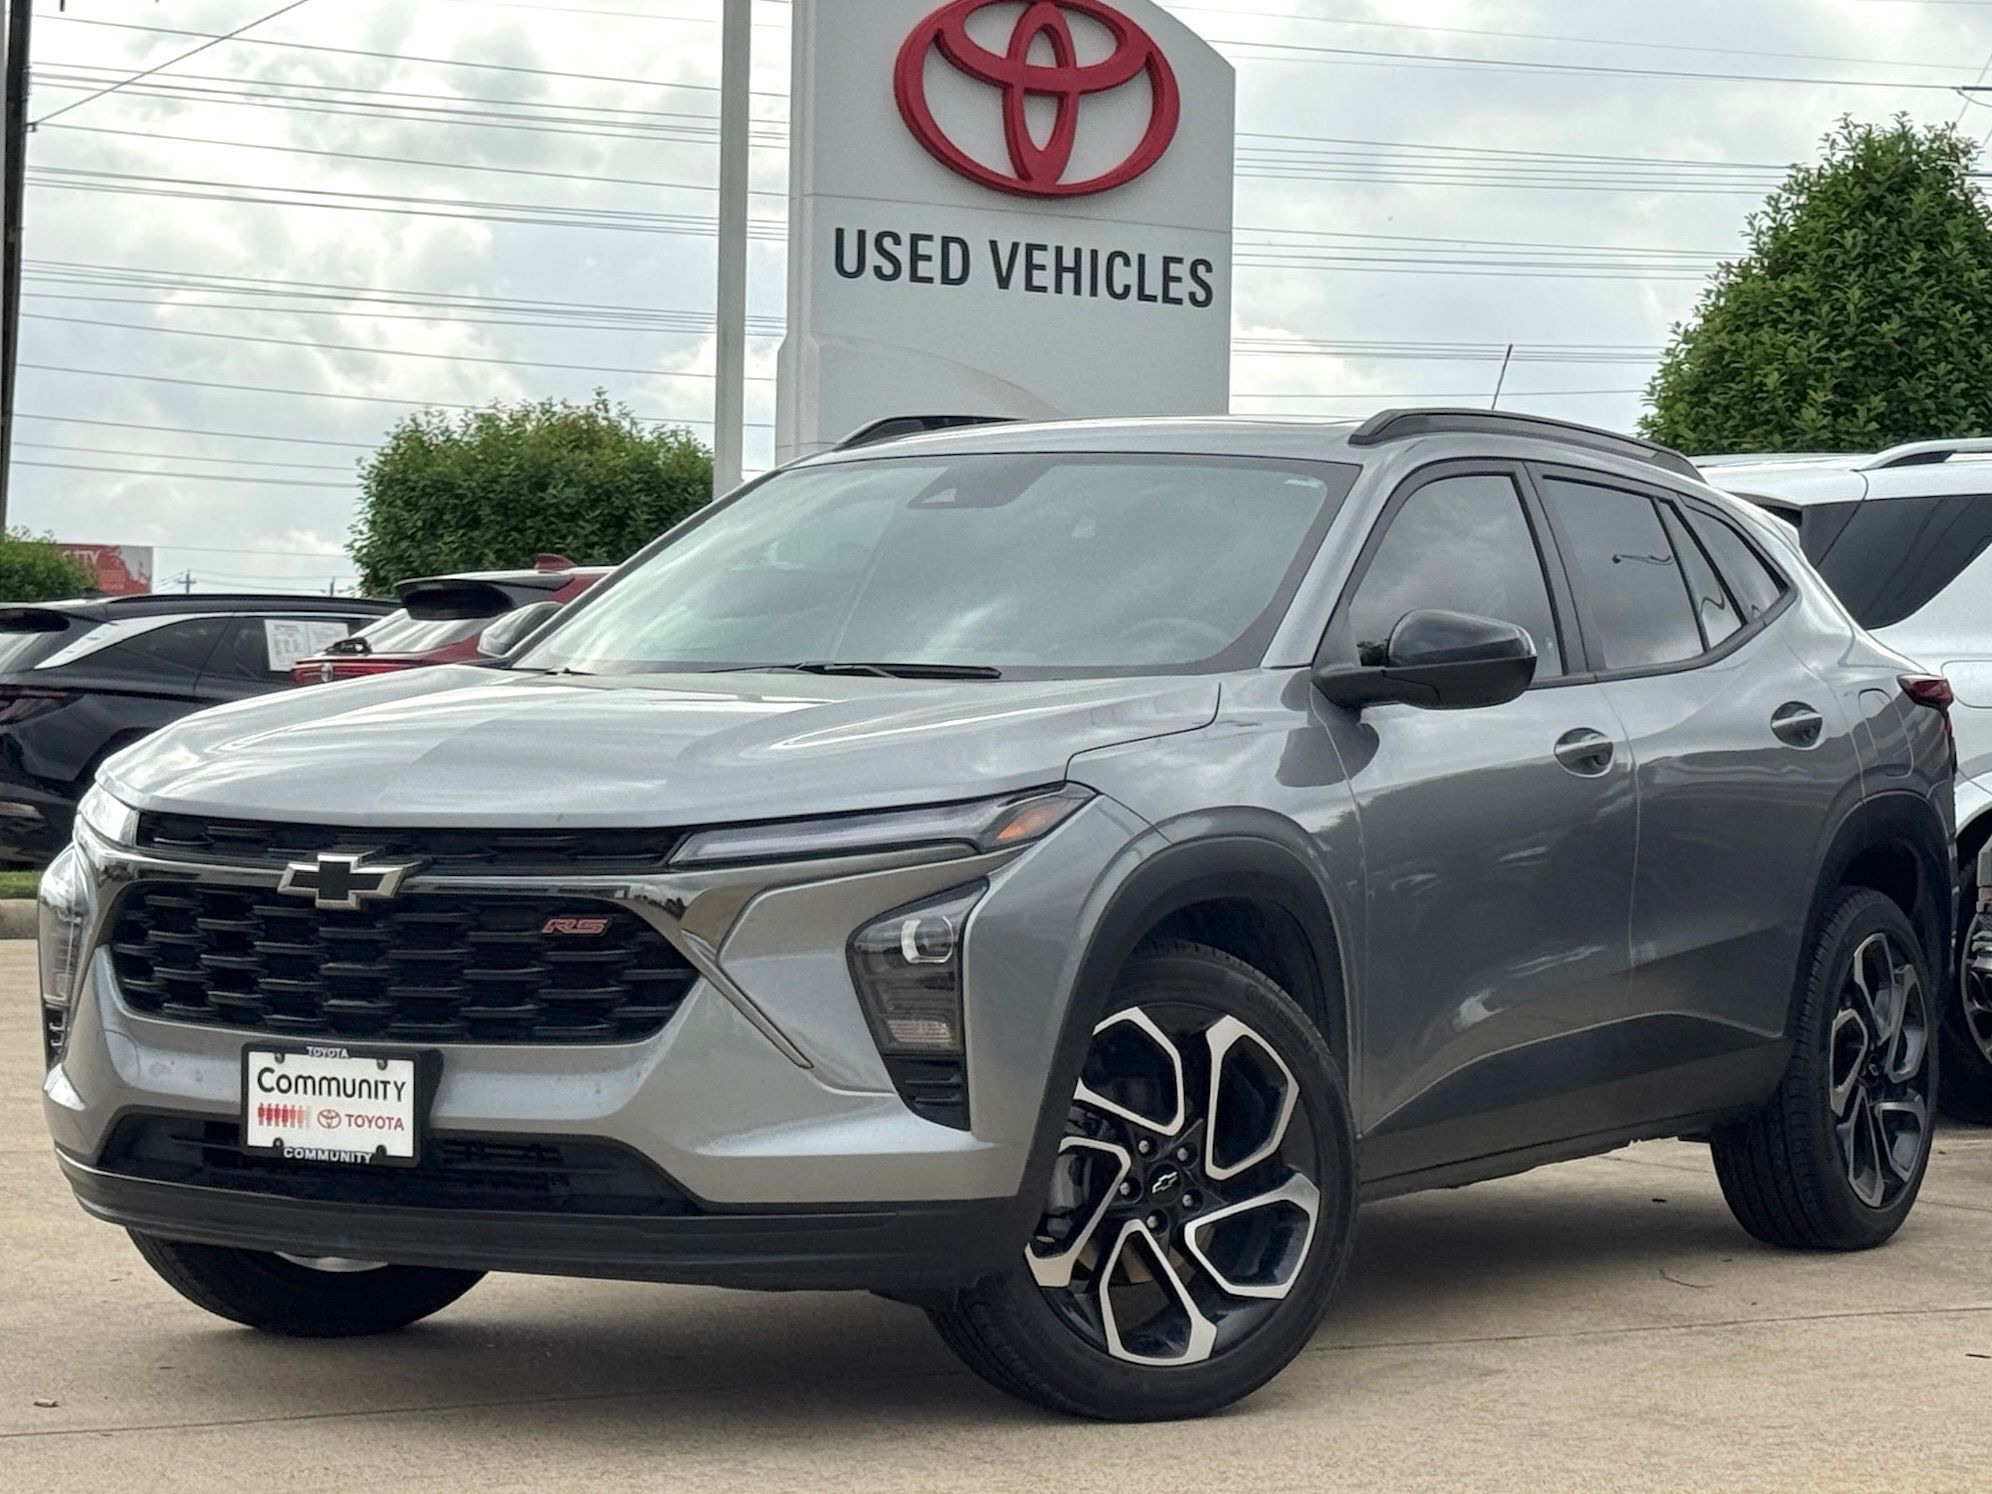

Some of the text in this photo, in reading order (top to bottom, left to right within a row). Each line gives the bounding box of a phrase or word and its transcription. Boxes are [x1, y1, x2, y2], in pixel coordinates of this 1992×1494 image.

[834, 227, 1214, 308] USED VEHICLES
[541, 918, 608, 934] RS
[306, 1045, 350, 1059] TOYOTA
[345, 1113, 405, 1132] TOYOTA
[283, 1146, 374, 1165] COMMUNITY
